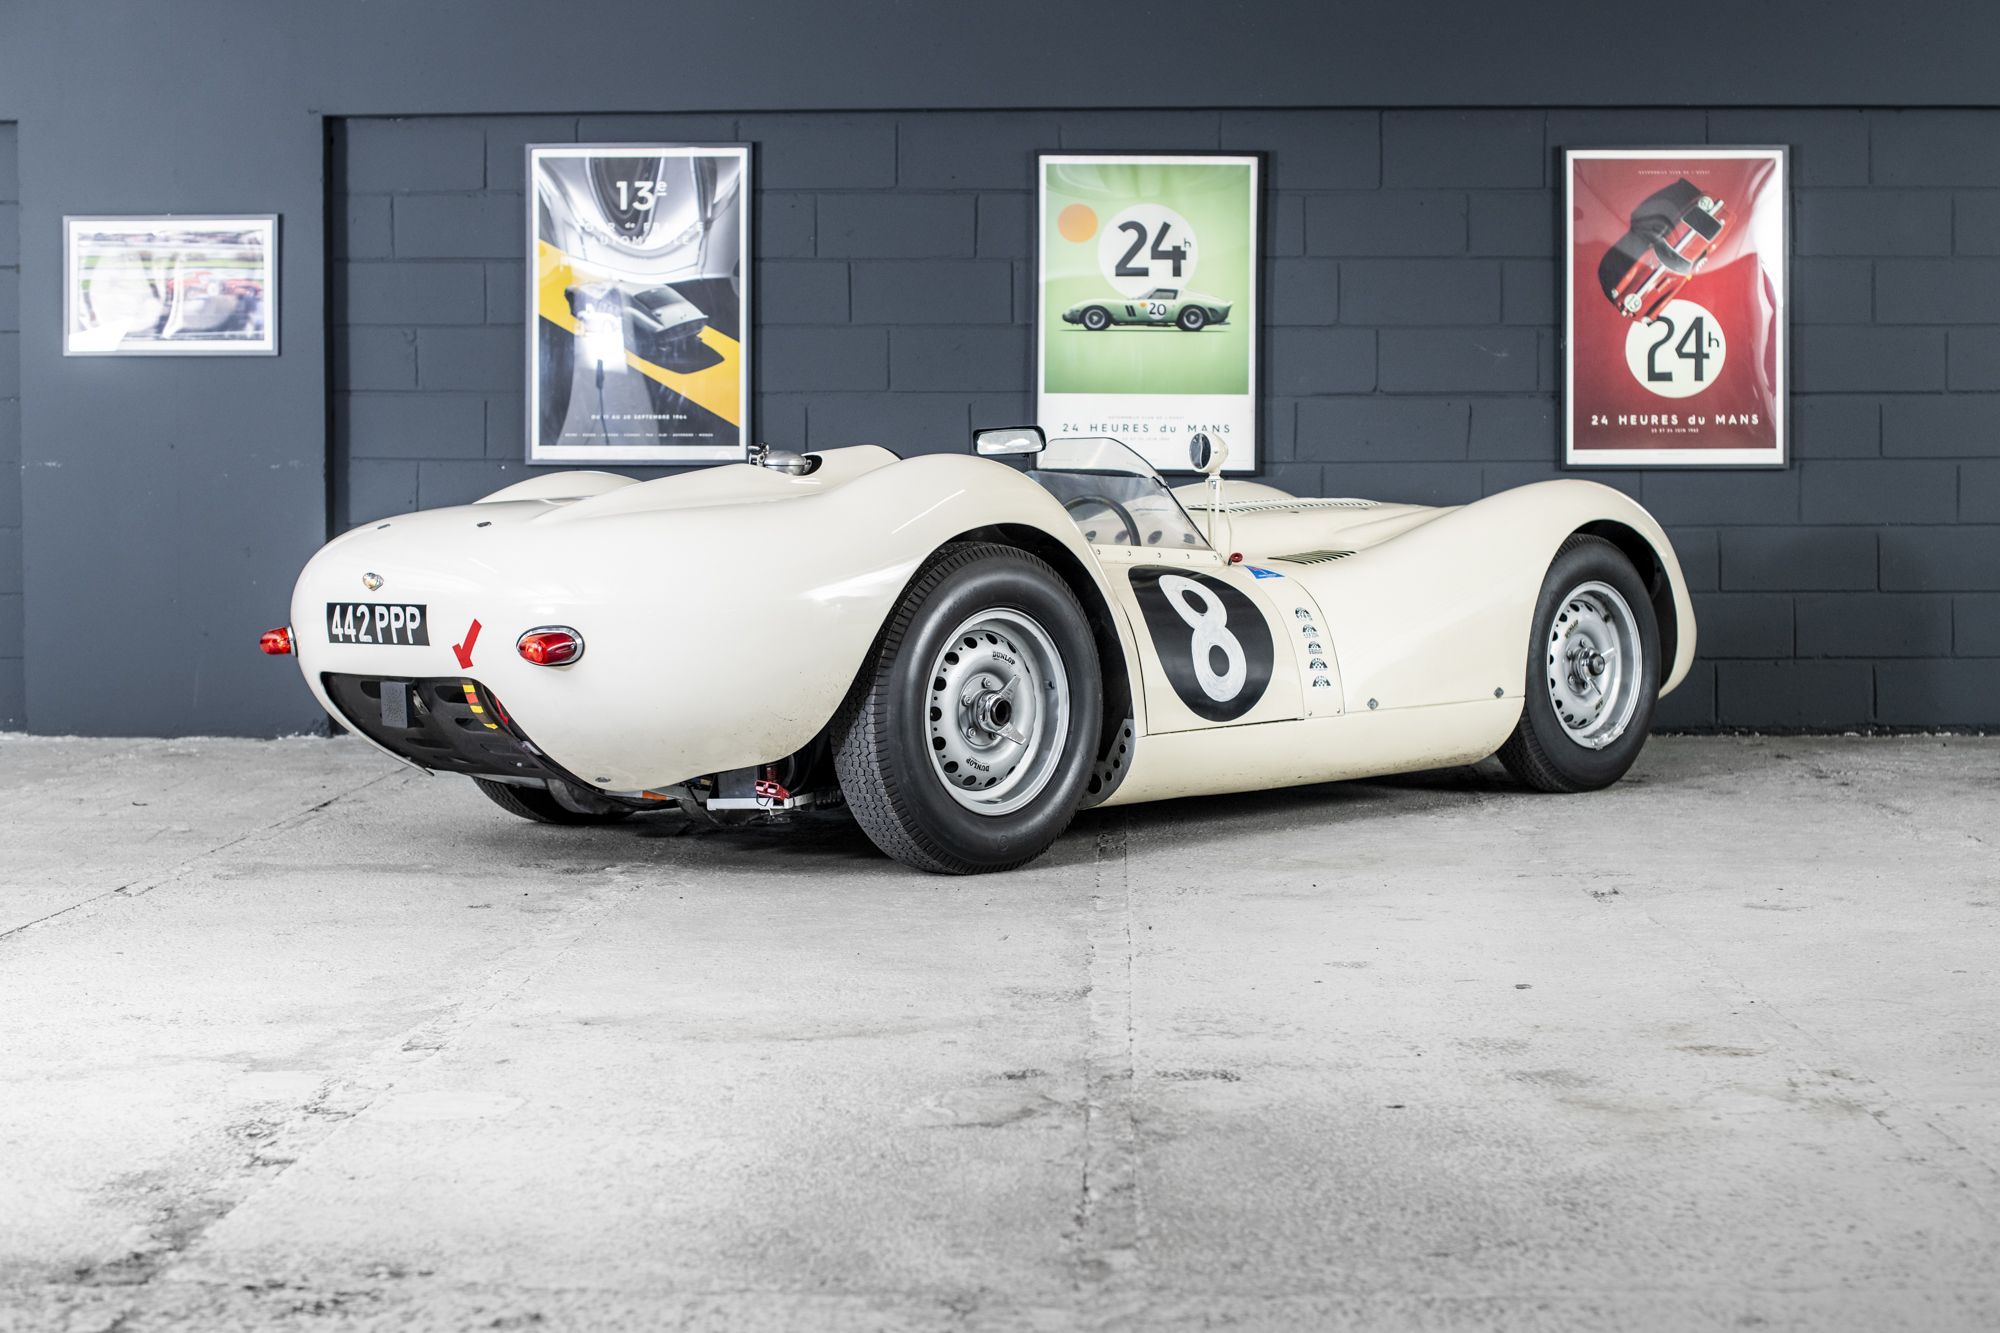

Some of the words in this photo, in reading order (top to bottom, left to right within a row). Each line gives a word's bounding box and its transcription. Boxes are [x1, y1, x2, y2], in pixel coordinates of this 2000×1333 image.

[1149, 303, 1167, 316] 20
[1591, 415, 1608, 425] 24
[1618, 414, 1679, 425] HEURES
[1688, 414, 1705, 425] du
[1716, 414, 1759, 425] MANS
[1063, 423, 1079, 432] 24
[1090, 423, 1149, 433] HEURES
[1160, 424, 1176, 433] du
[1188, 424, 1230, 433] MANS
[332, 605, 373, 642] 442
[375, 605, 421, 644] PPP
[1158, 574, 1247, 702] 8
[992, 651, 1015, 665] DUNLOP
[966, 758, 989, 771] DUNLOP
